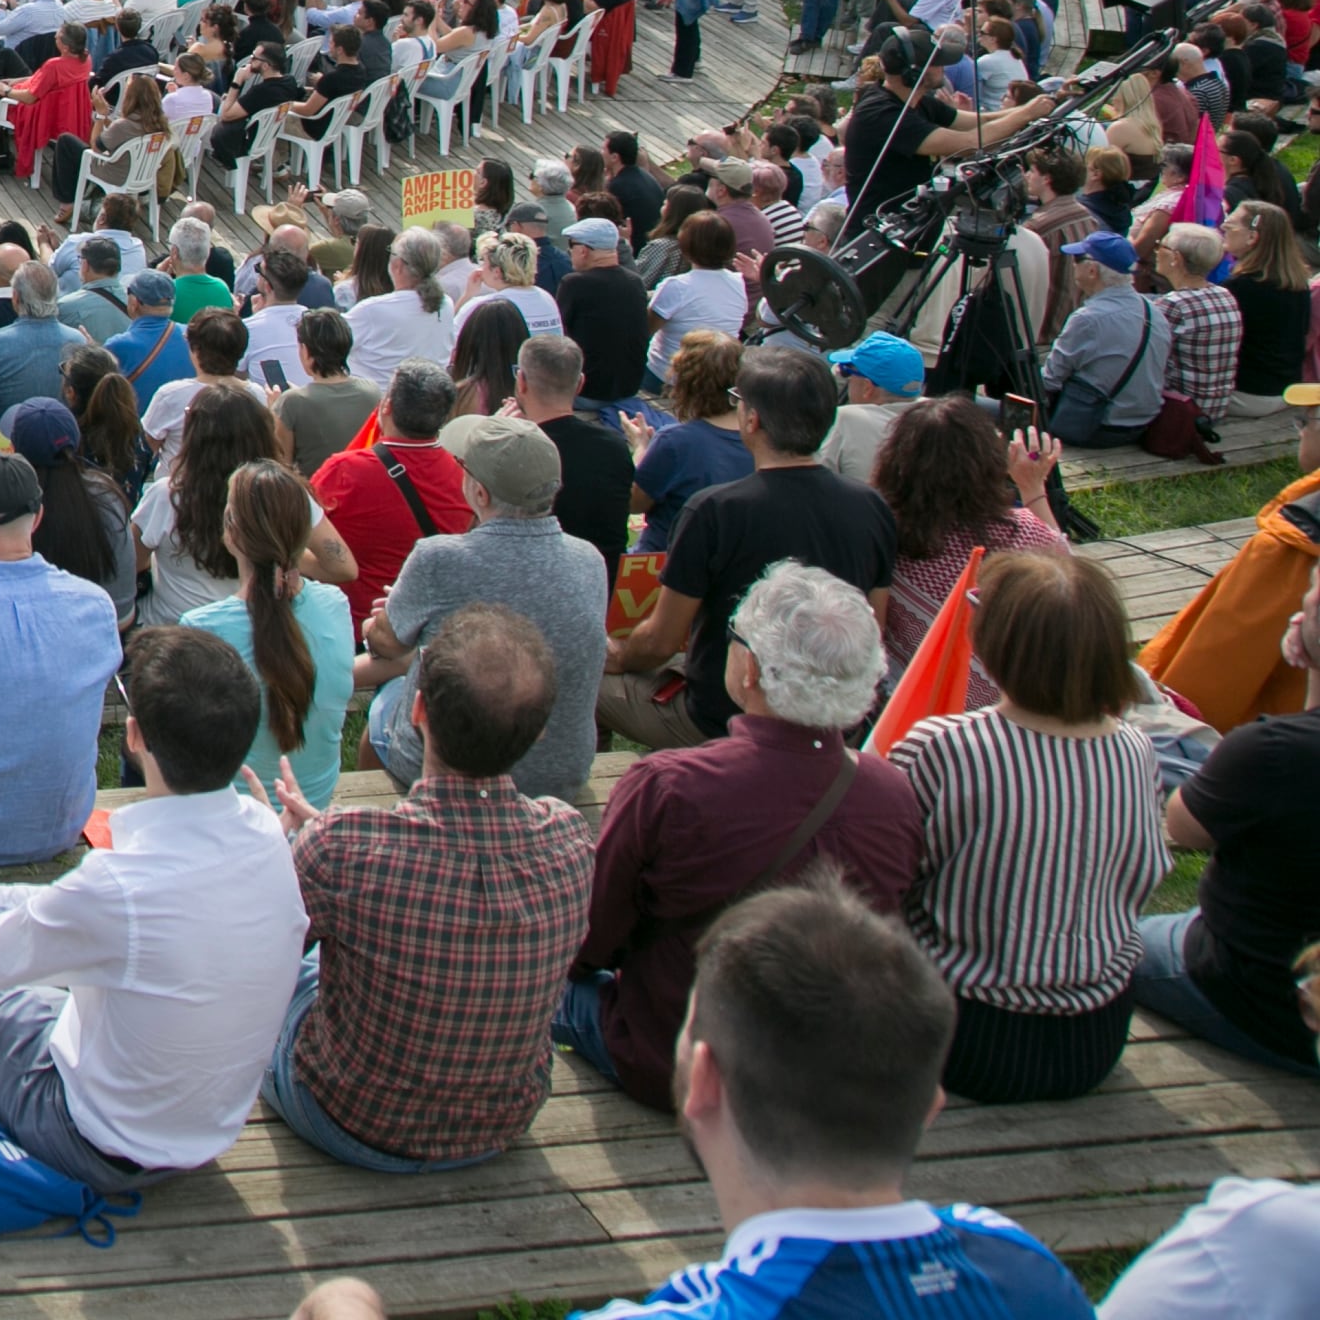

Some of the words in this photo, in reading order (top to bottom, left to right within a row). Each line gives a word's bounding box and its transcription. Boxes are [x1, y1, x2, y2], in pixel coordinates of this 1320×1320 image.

[403, 169, 474, 198] AMPLIO
[403, 188, 474, 208] AMPLIO
[403, 199, 475, 218] AMPLIO
